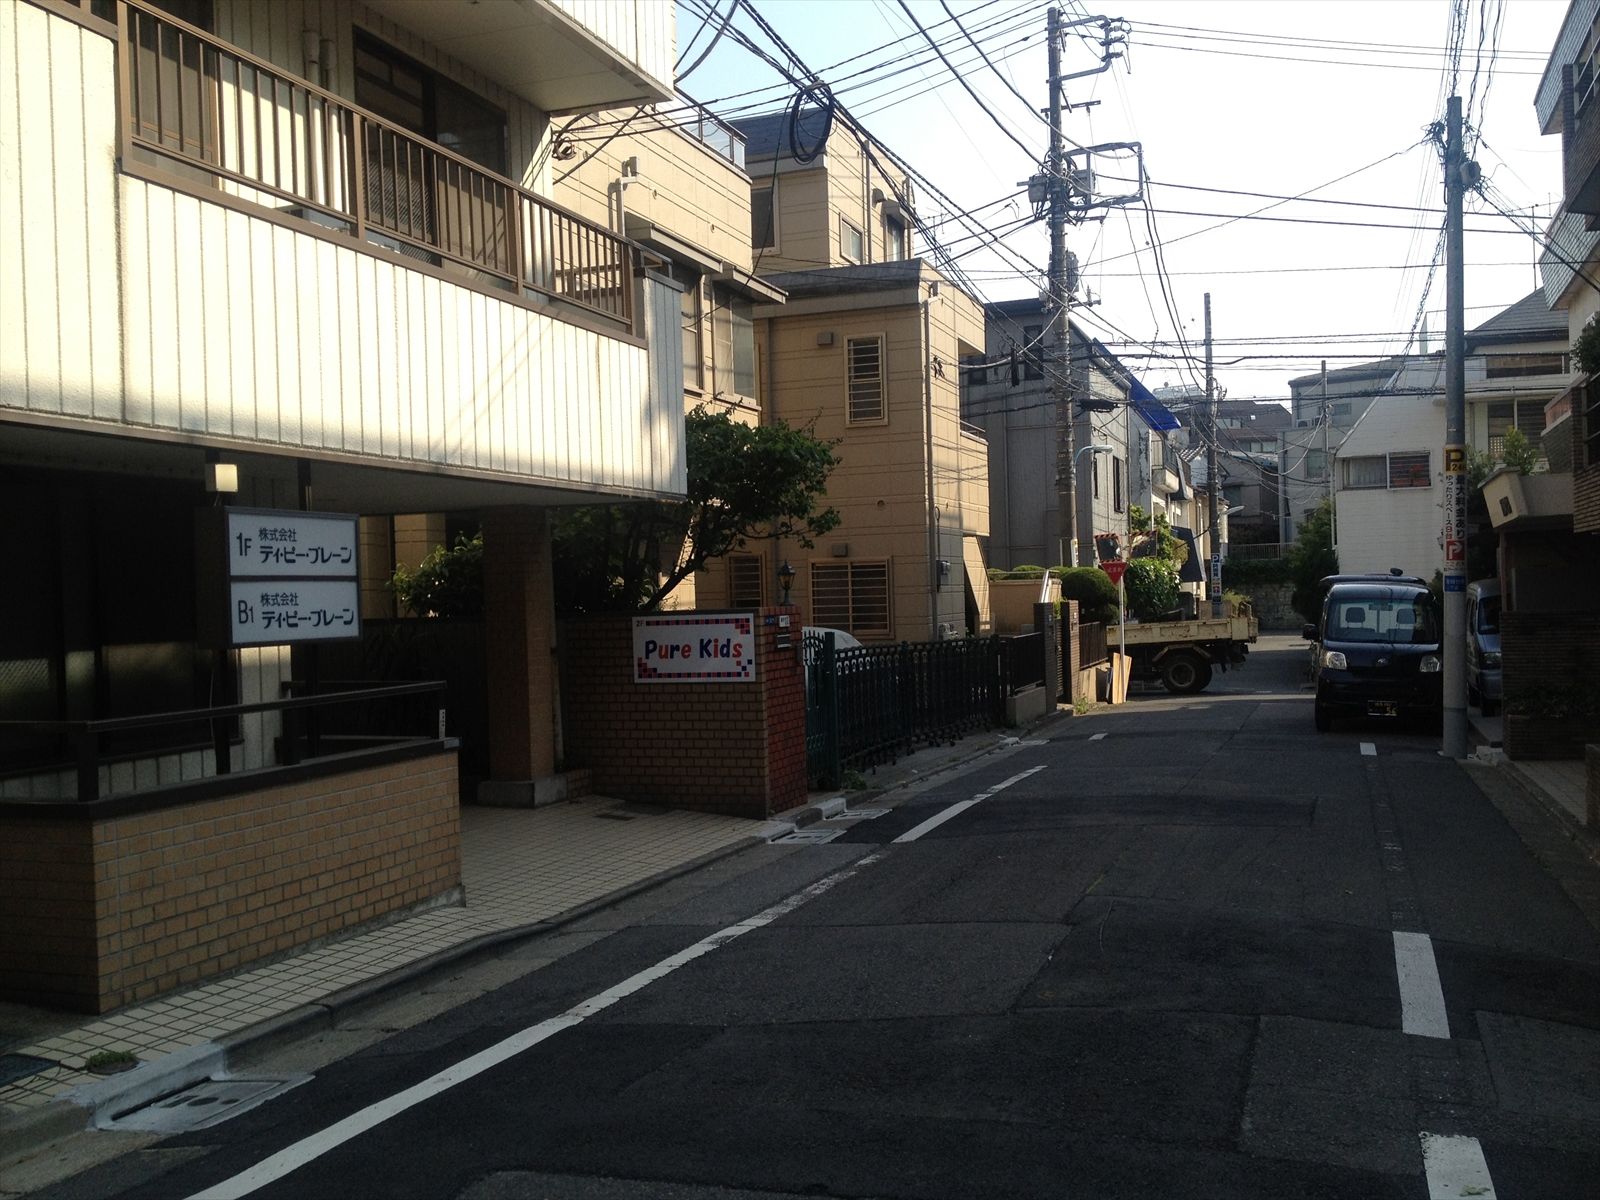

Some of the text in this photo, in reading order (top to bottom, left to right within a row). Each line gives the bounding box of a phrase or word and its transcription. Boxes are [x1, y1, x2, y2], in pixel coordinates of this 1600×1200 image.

[236, 532, 252, 556] 1F
[259, 528, 297, 542] 株式会社
[260, 592, 299, 607] 株式会社
[238, 600, 254, 624] B1
[645, 638, 743, 660] Pure Kids
